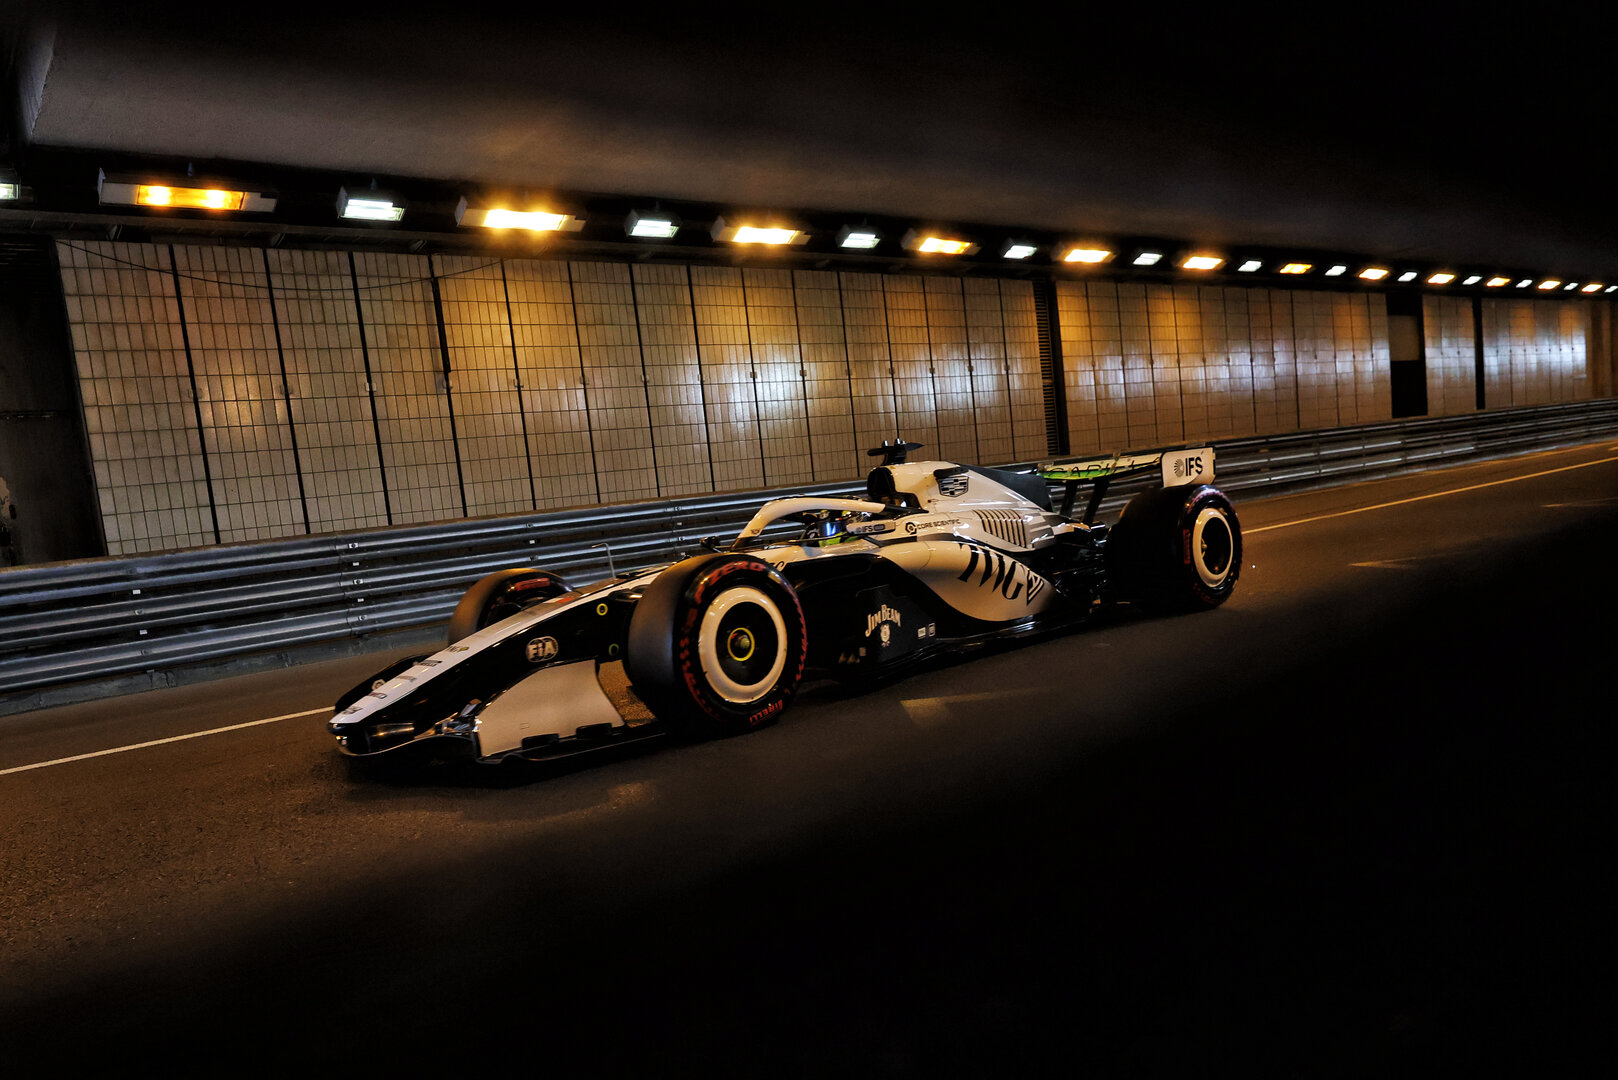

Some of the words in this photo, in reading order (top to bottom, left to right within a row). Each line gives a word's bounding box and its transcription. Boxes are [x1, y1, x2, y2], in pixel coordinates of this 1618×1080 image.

[1185, 456, 1203, 477] IFS
[862, 524, 873, 533] IFS
[917, 521, 933, 530] CORE
[708, 560, 766, 586] ZERO
[957, 543, 1025, 600] TWG
[865, 610, 882, 638] JIM
[881, 603, 902, 628] BEAM
